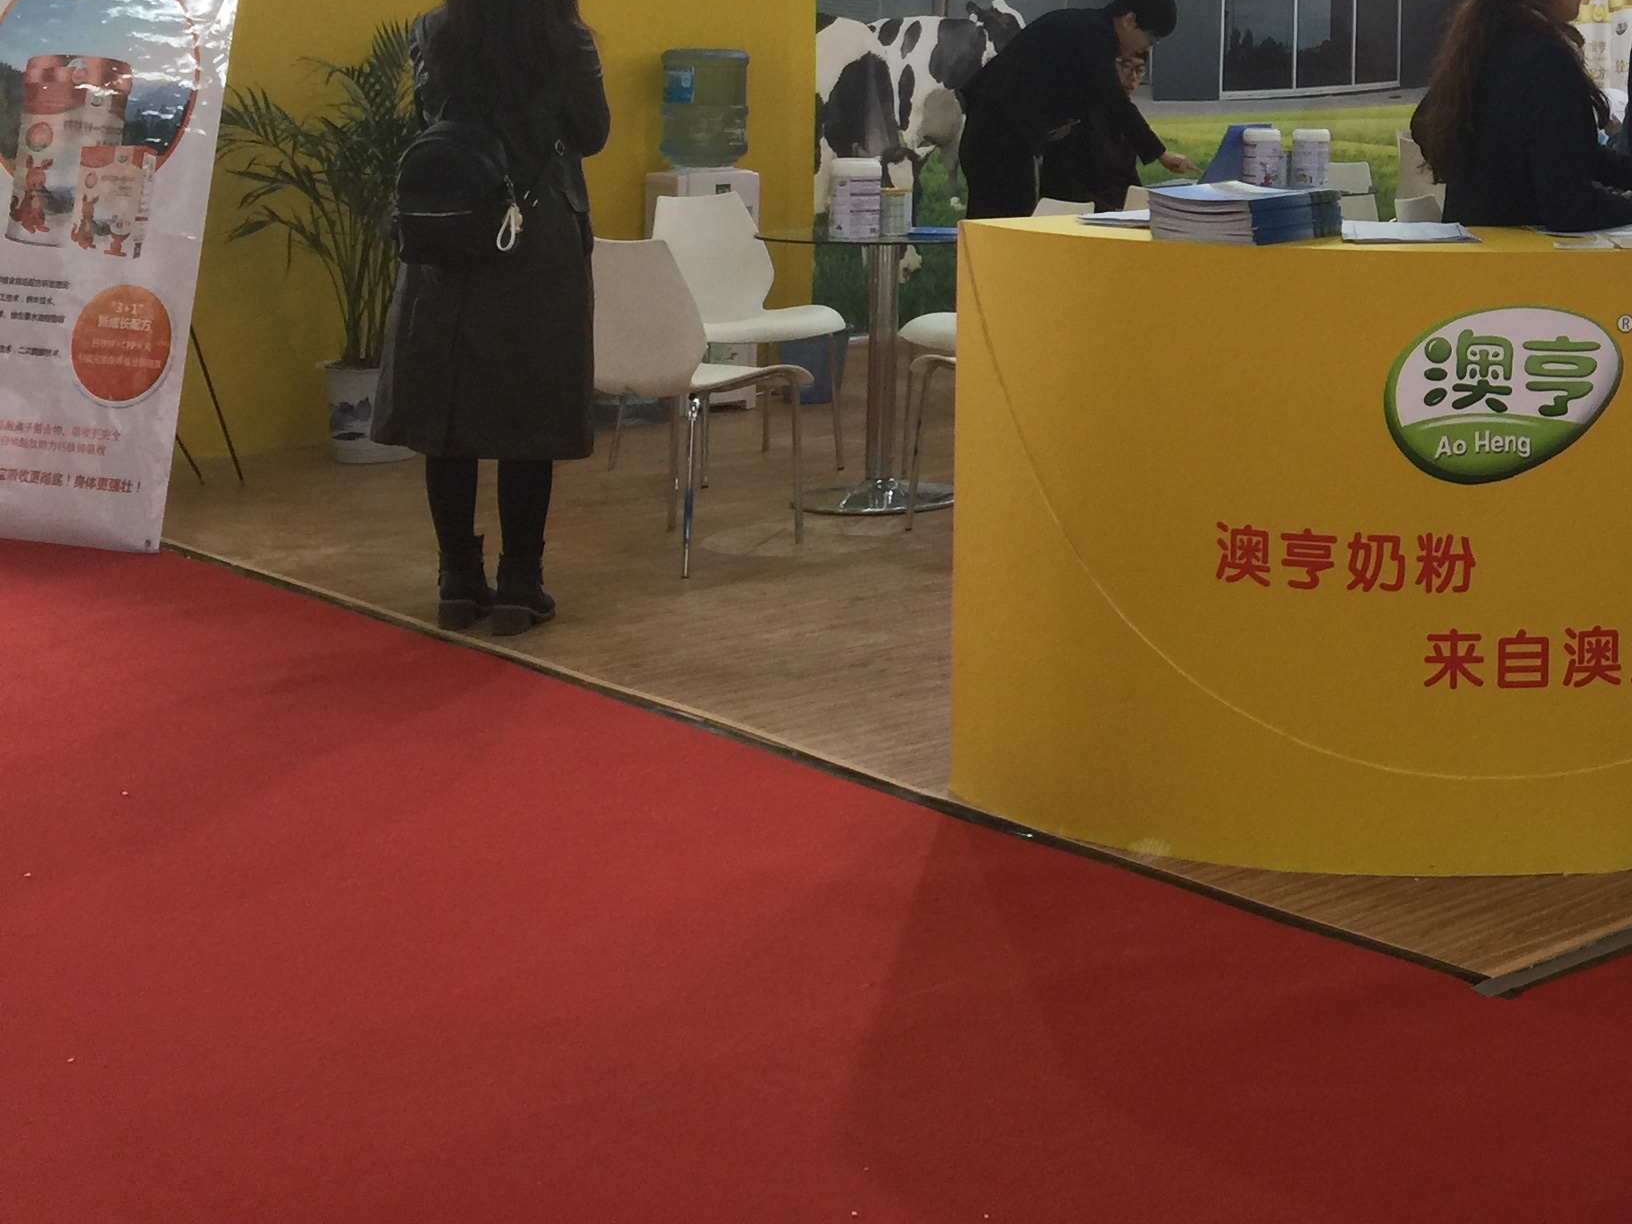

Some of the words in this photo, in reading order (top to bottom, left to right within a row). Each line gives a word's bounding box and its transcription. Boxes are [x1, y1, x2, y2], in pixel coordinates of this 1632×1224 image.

[1424, 329, 1602, 417] 澳亨
[1434, 435, 1468, 459] Ao
[1474, 430, 1533, 457] Heng
[1215, 520, 1477, 594] 澳亨奶粉
